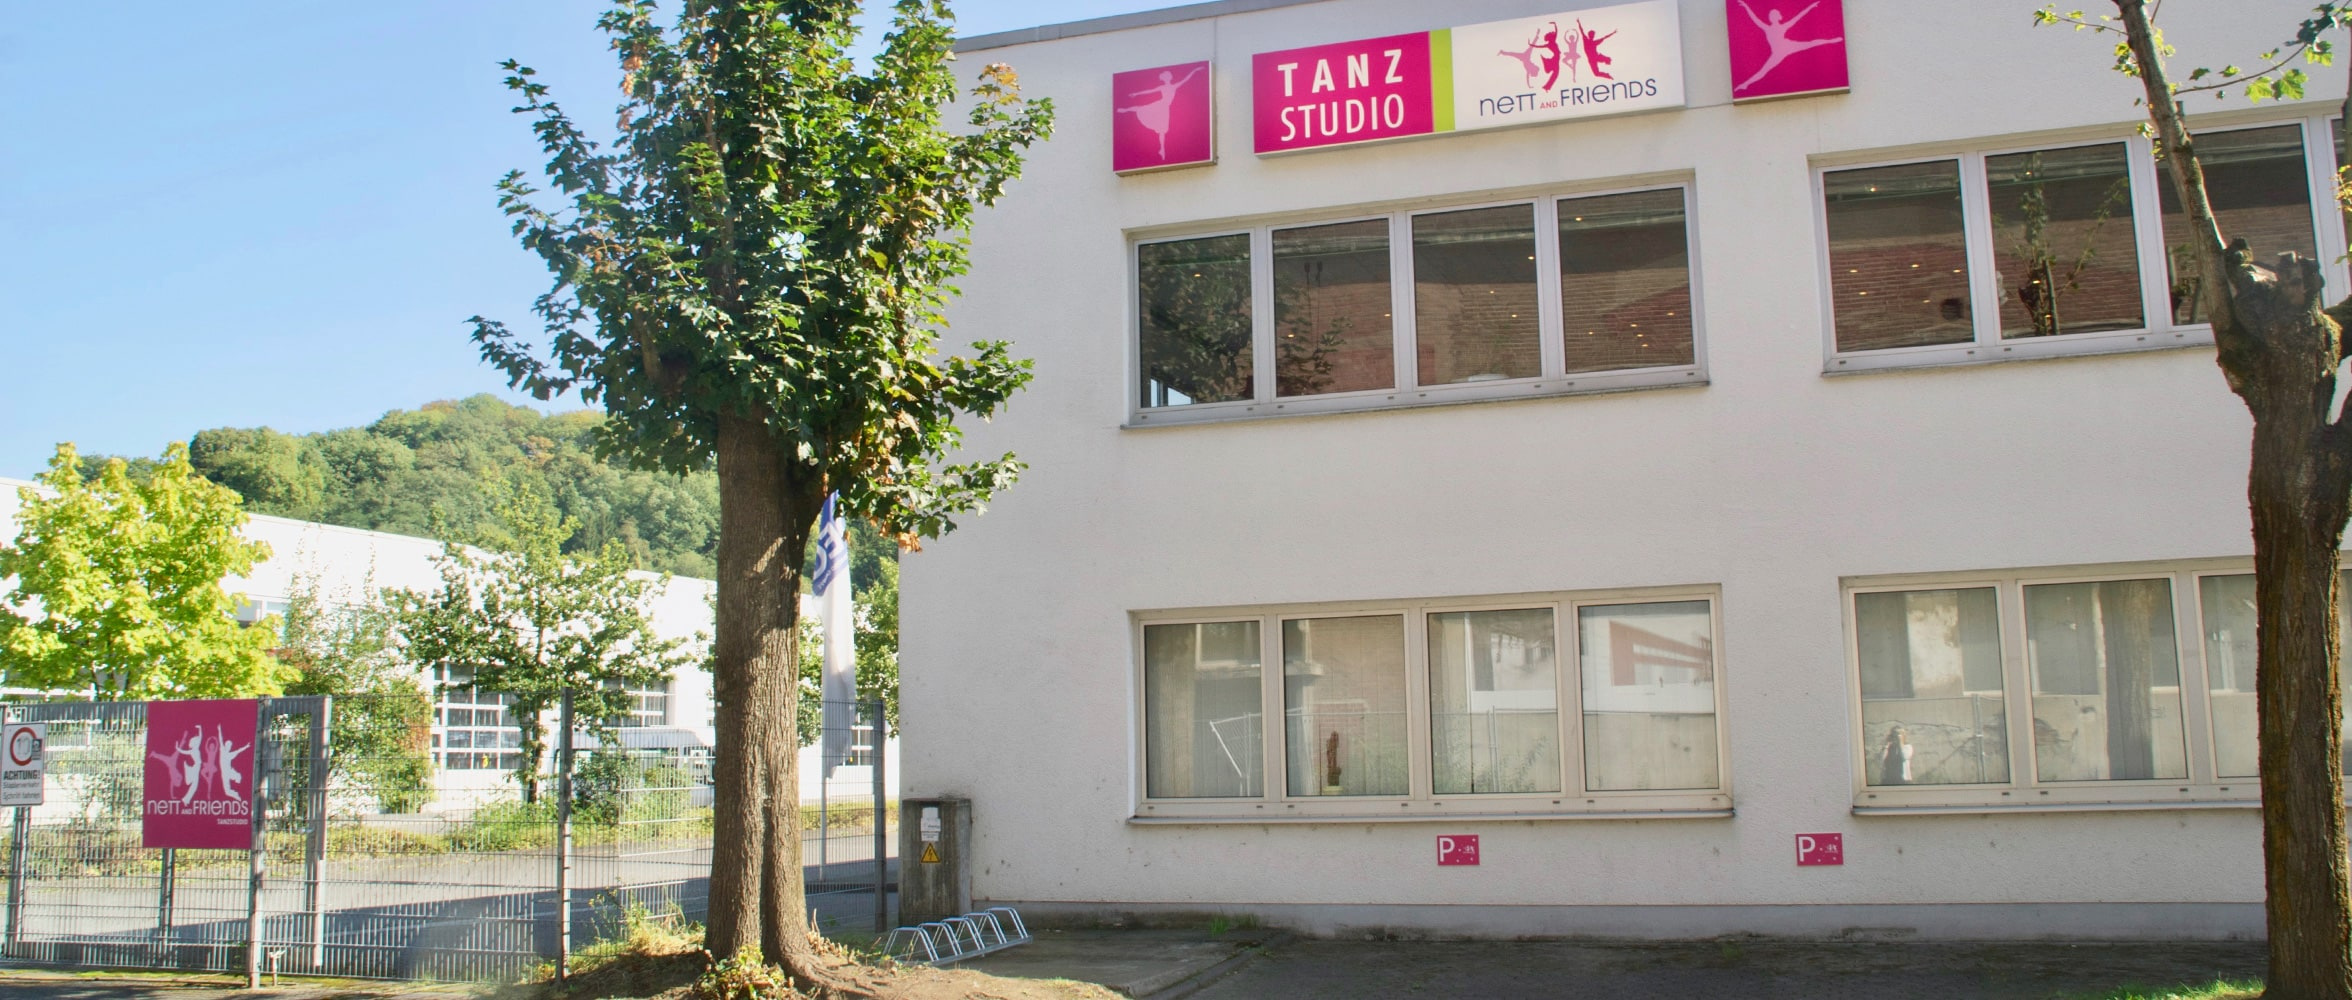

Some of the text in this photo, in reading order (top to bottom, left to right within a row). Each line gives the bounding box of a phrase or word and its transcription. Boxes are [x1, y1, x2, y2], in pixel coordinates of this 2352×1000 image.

[1277, 48, 1403, 97] TANZ
[1280, 93, 1405, 142] STUDIO
[1539, 100, 1558, 110] AND
[3, 769, 41, 780] ACHTUNG!
[1439, 837, 1456, 862] P
[1798, 836, 1816, 862] P
